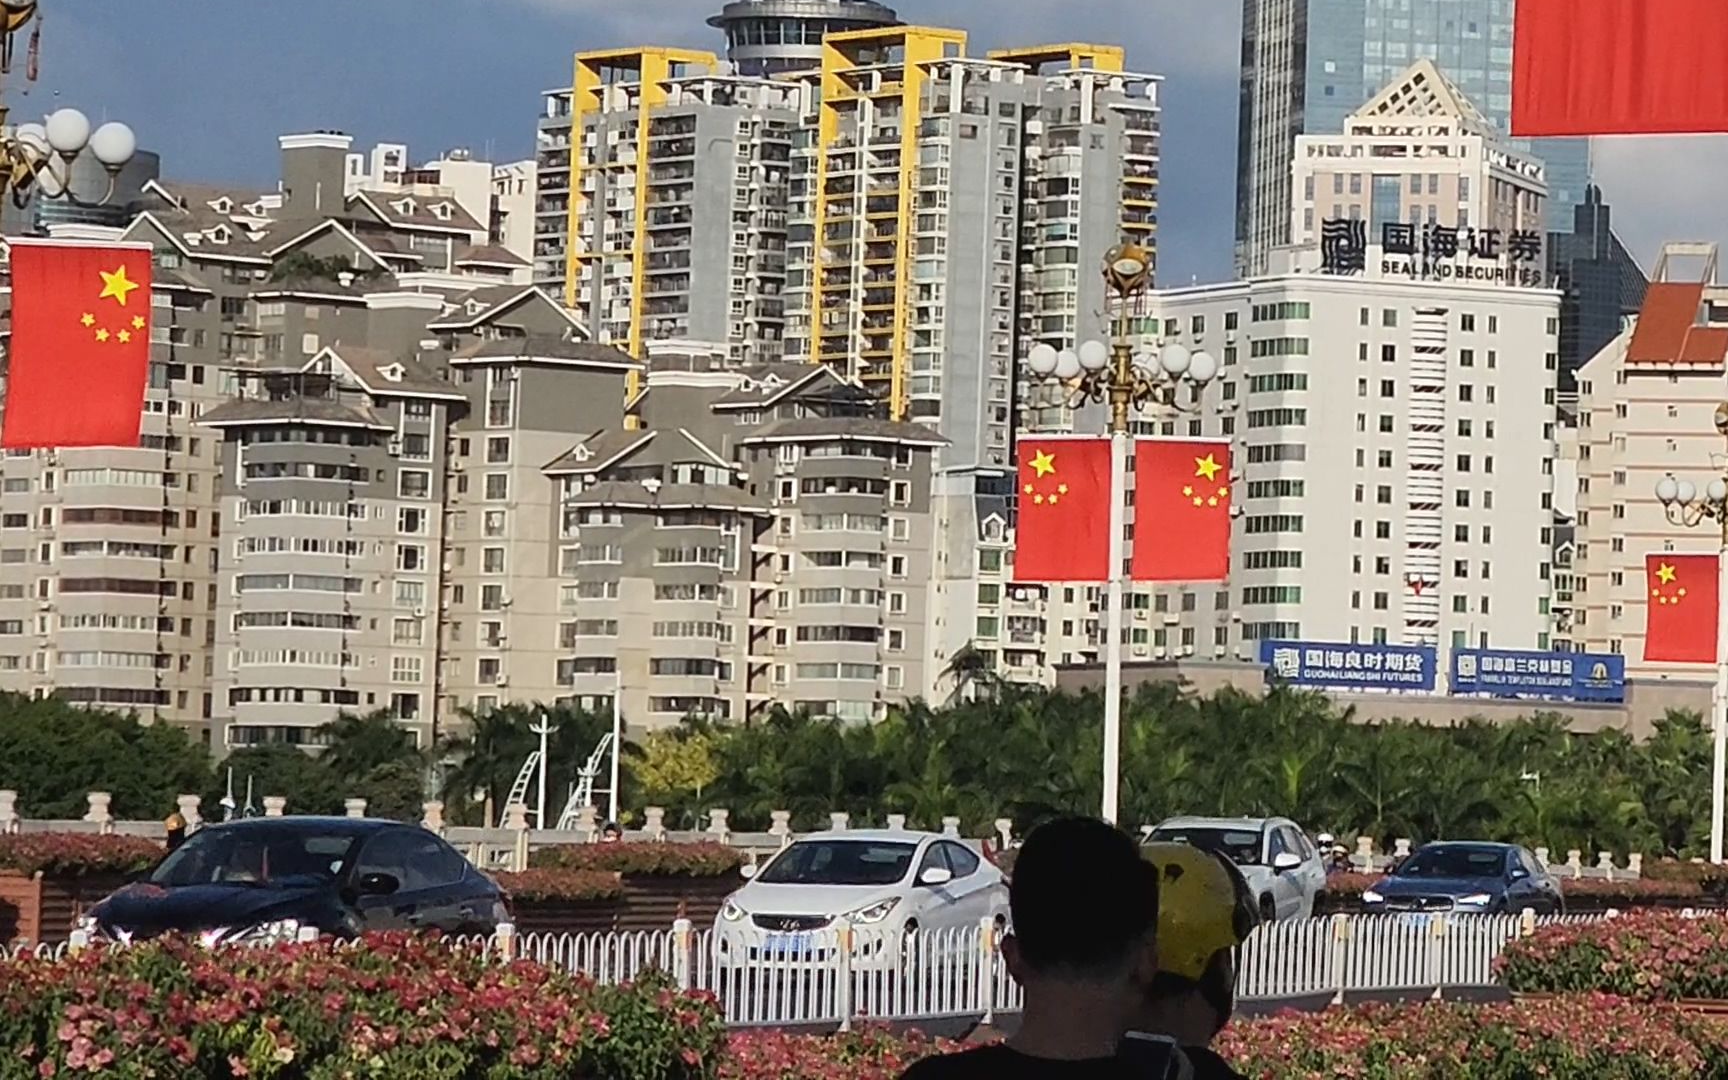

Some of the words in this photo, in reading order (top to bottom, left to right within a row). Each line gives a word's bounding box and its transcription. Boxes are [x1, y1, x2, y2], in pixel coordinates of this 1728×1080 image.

[1382, 222, 1542, 261] 国海证券
[1381, 260, 1451, 280] SEALAND
[1455, 265, 1542, 286] SECURITIES
[1305, 649, 1424, 672] 国海良时期货
[1382, 672, 1424, 683] FUTURES
